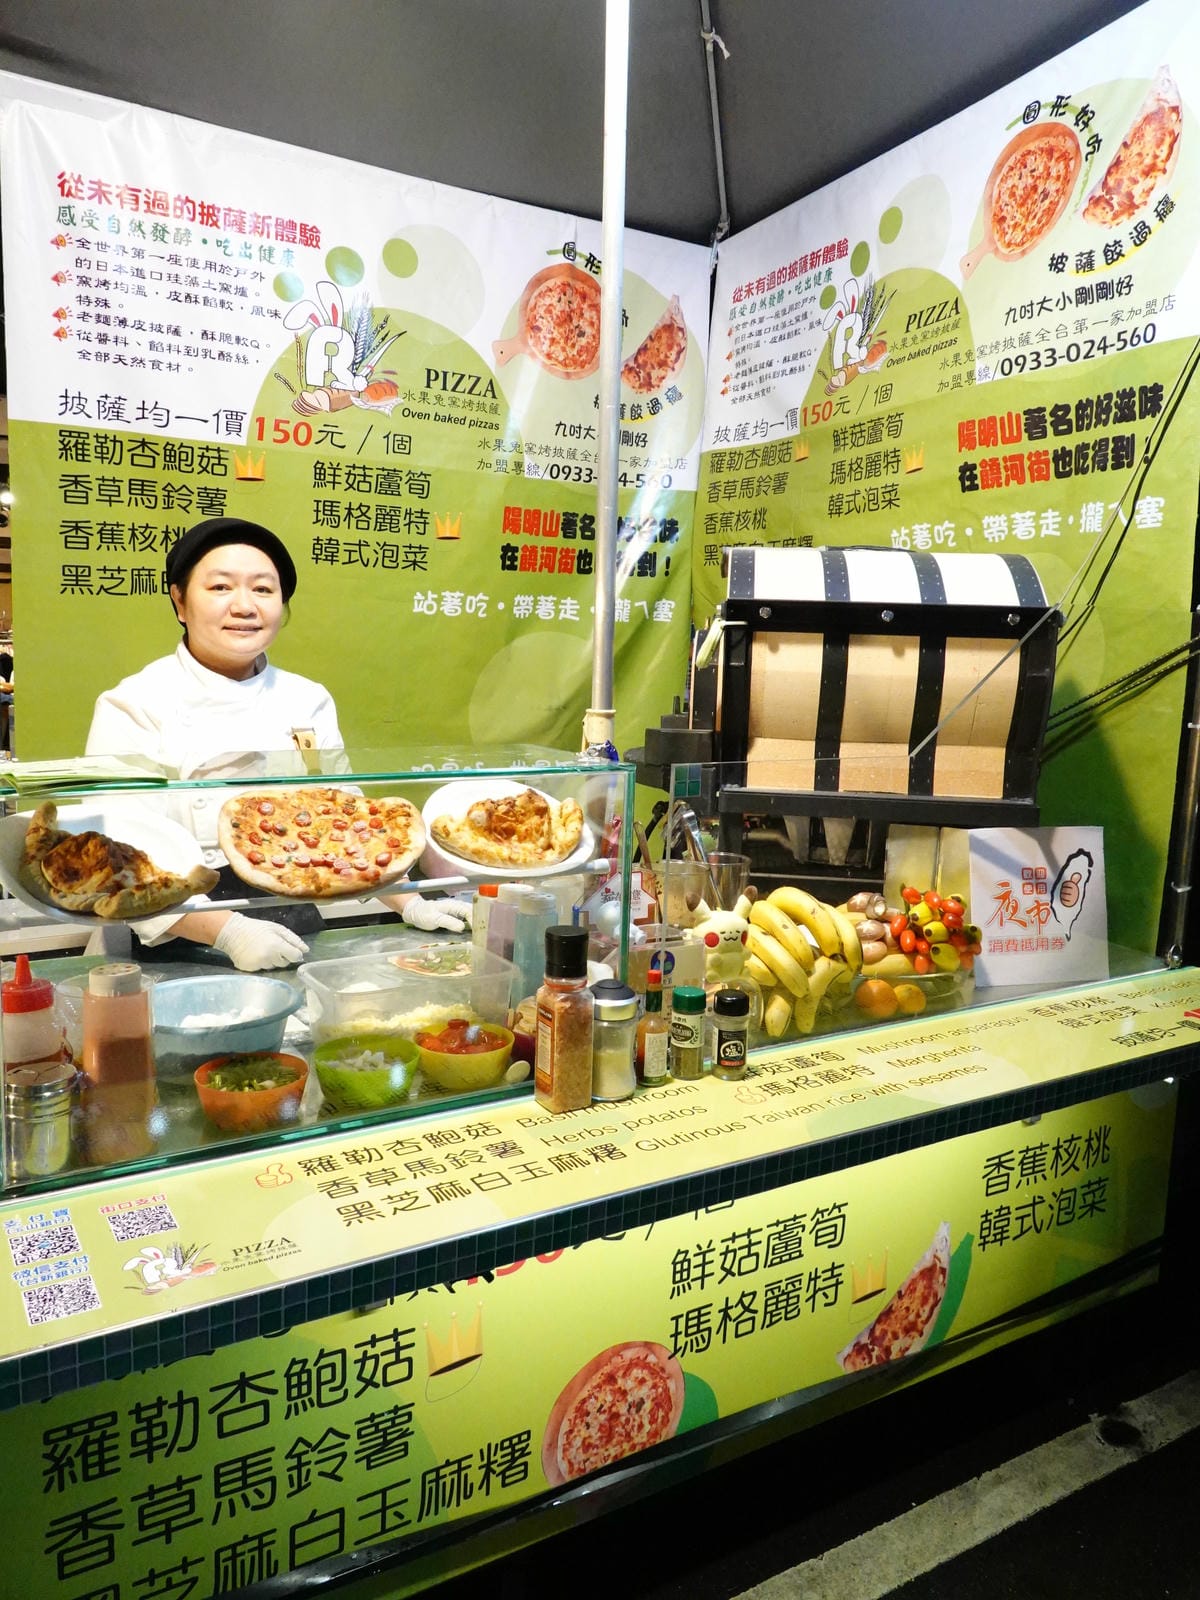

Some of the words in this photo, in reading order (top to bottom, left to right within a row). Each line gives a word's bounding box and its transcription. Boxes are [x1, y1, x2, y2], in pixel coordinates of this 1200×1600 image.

[57, 170, 321, 250] 從未有過的披薩新體驗
[1048, 193, 1176, 274] 披薩餃過癮
[732, 238, 849, 305] 從未有過的披薩新體驗
[906, 297, 960, 333] PIZZA
[1004, 274, 1134, 327] 九吋大小剛剛好
[886, 354, 906, 368] Oven
[907, 344, 931, 362] baked
[932, 336, 958, 356] pizzas
[424, 368, 498, 399] PIZZA
[401, 407, 430, 422] Oven
[433, 411, 467, 426] baked
[469, 417, 500, 431] pizzas
[555, 421, 648, 448] 九吋大剛好
[832, 412, 904, 454] 鮮菇蘆筍
[957, 382, 1164, 453] 陽明山著名的好滋味
[57, 429, 230, 478] 羅勒杏鮑菇
[710, 441, 793, 474] 羅勒杏鮑菇
[830, 449, 902, 485] 瑪格麗特
[58, 472, 228, 517] 香草馬鈴薯
[312, 460, 432, 500] 鮮菇蘆筍
[707, 472, 789, 503] 香草馬鈴薯
[827, 483, 900, 518] 韓式泡菜
[312, 499, 431, 536] 瑪格麗特
[704, 507, 767, 535] 香蕉核桃
[311, 535, 430, 572] 韓式泡菜
[986, 881, 1051, 935] 夜市
[856, 1031, 945, 1058] Mushroom
[948, 1014, 1029, 1037] asparagus
[887, 1045, 982, 1069] Margherita
[758, 1064, 876, 1097] 瑪格麗特
[540, 1125, 618, 1147] Herbs
[622, 1105, 708, 1131] potatos
[635, 1120, 747, 1152] Glutinous
[746, 1101, 825, 1126] Taiwan
[825, 1091, 866, 1106] rice
[870, 1081, 905, 1097] with
[908, 1065, 987, 1087] sesames
[298, 1121, 502, 1176] 羅勒杏鮑菇
[317, 1140, 525, 1199] 香草馬鈴薯
[982, 1124, 1111, 1197] 香蕉核桃
[100, 1194, 167, 1214] 街口支付
[335, 1145, 627, 1227] 黑芝麻白玉麻糬
[979, 1176, 1109, 1251] 韓式泡菜
[13, 1255, 89, 1281] 微信支付
[232, 1237, 292, 1256] PIZZA
[669, 1202, 848, 1300] 鮮菇蘆筍
[669, 1262, 846, 1360] 瑪格麗特
[42, 1327, 416, 1495] 羅勒杏鮑菇
[44, 1402, 416, 1581] 香草馬鈴薯
[70, 1429, 532, 1600] 芝麻白玉麻糬
